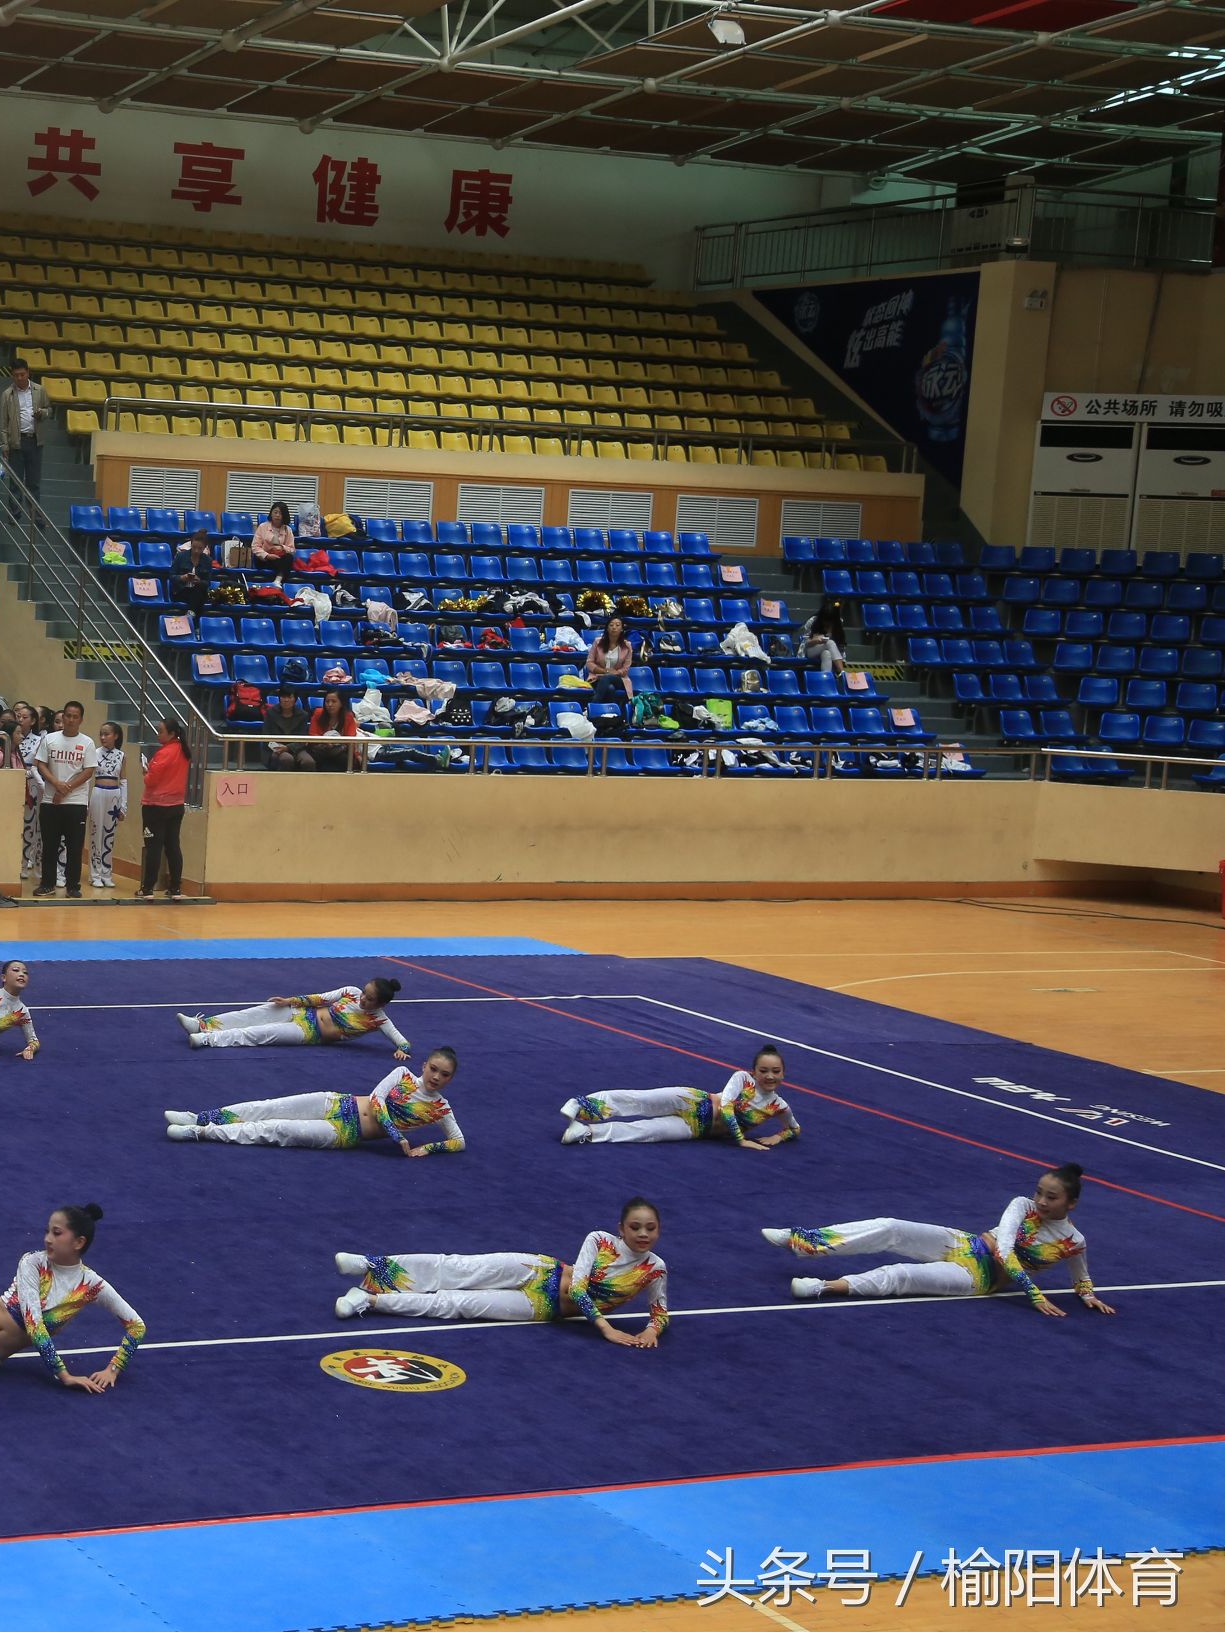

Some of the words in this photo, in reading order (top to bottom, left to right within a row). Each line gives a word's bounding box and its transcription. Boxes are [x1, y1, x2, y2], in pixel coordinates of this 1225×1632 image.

[1085, 399, 1158, 417] 公共场所
[1169, 400, 1225, 418] 请勿吸
[50, 749, 83, 762] CHINA
[222, 782, 249, 797] 入口
